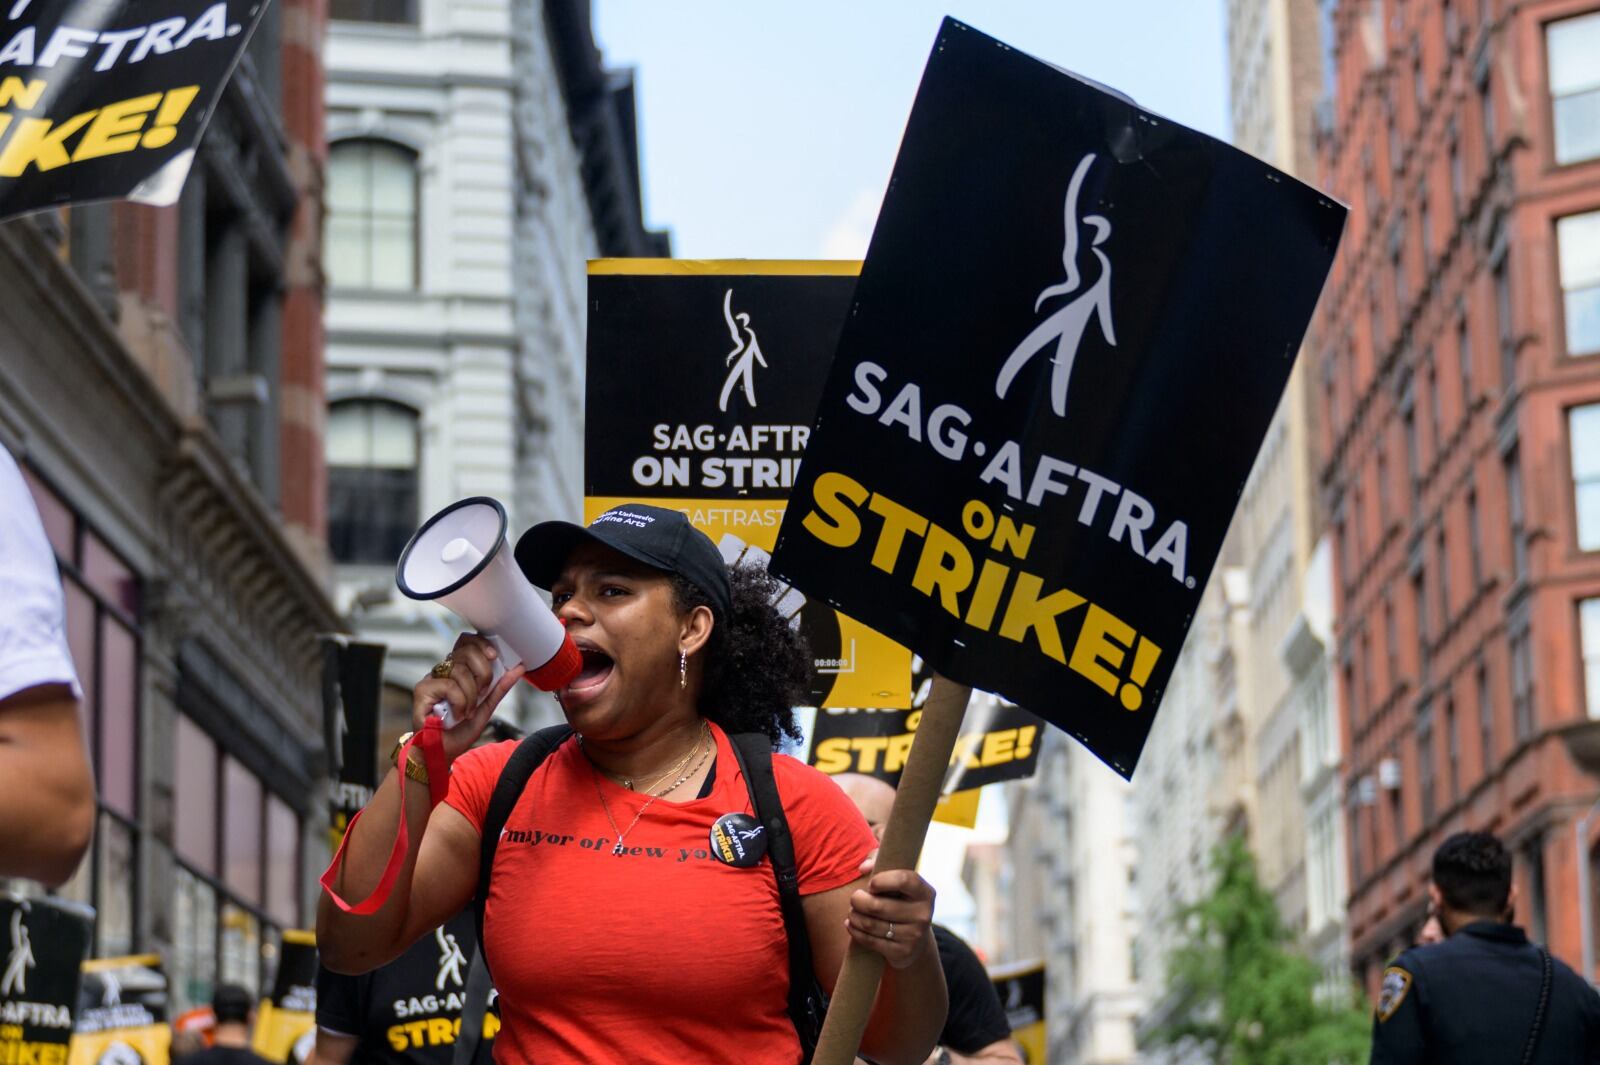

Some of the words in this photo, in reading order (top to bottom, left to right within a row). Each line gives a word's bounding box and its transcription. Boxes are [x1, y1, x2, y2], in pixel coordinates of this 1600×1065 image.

[632, 457, 690, 487] ON
[623, 517, 646, 528] Arts
[961, 499, 1037, 559] ON
[801, 471, 1163, 712] STRIKE!
[815, 726, 1036, 773] STRKE!
[580, 837, 610, 851] of
